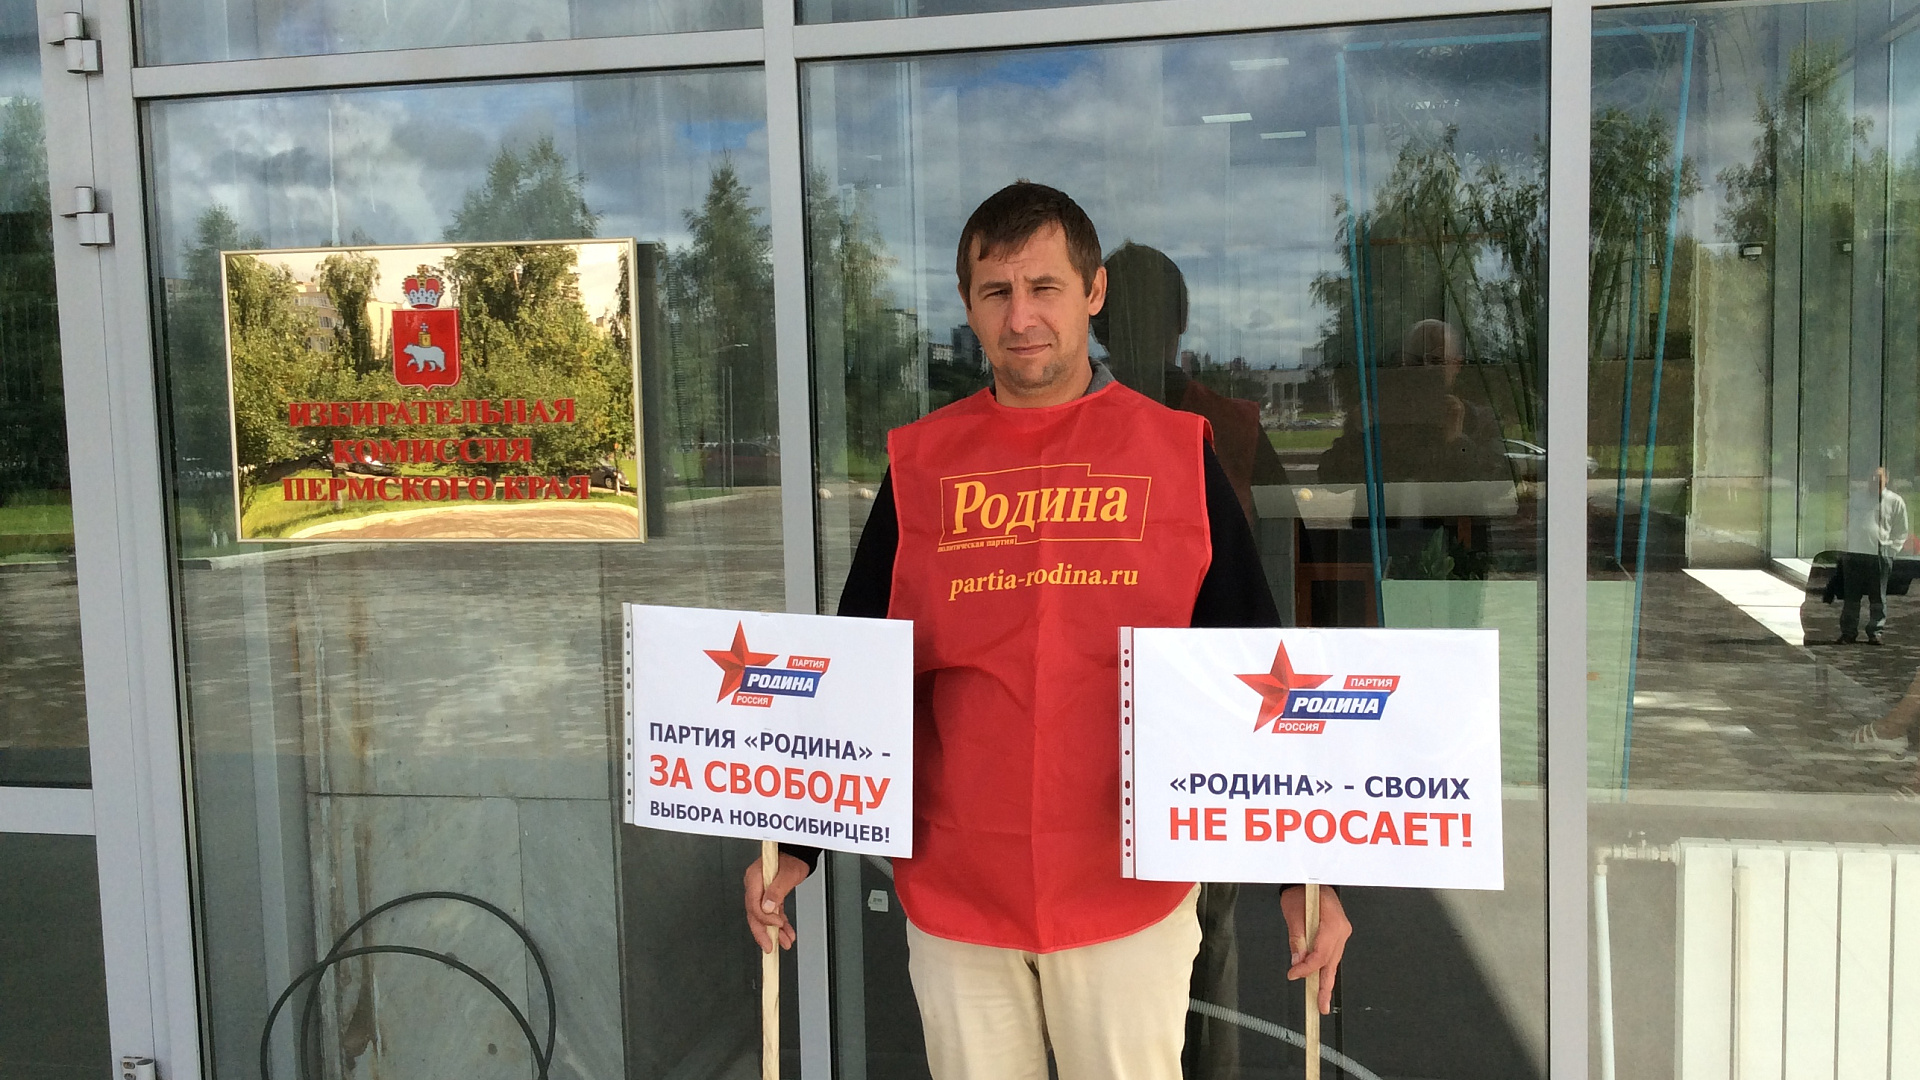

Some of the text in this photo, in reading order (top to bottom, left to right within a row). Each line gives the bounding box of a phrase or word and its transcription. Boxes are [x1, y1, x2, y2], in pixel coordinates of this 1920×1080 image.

[288, 398, 576, 427] ИЗБИРАТЕЛЬНАЯ
[332, 437, 533, 465] КОМИССИЯ
[282, 475, 591, 502] ПЕРМСКОГО КРАЯ
[952, 480, 1129, 536] Родина
[986, 538, 1015, 548] партия
[948, 563, 1139, 602] partia-rodina.ru
[791, 658, 826, 669] ПАРТИЯ
[747, 673, 815, 692] РОДИНА
[1349, 677, 1394, 688] ПАРТИЯ
[736, 695, 769, 706] РОССИЯ
[1291, 697, 1380, 715] РОДИНА
[1278, 721, 1320, 732] РОССИЯ
[650, 722, 736, 749] ПАРТИЯ
[744, 731, 873, 761] «РОДИНА»
[649, 754, 891, 815] ЗА СВОБОДУ
[1169, 772, 1333, 800] «РОДИНА»
[1364, 776, 1471, 801] СВОИХ
[650, 800, 890, 844] ВЫБОРА НОВОСИБИРЦЕВ!
[1169, 807, 1473, 848] НЕ БРОСАЕТ!
